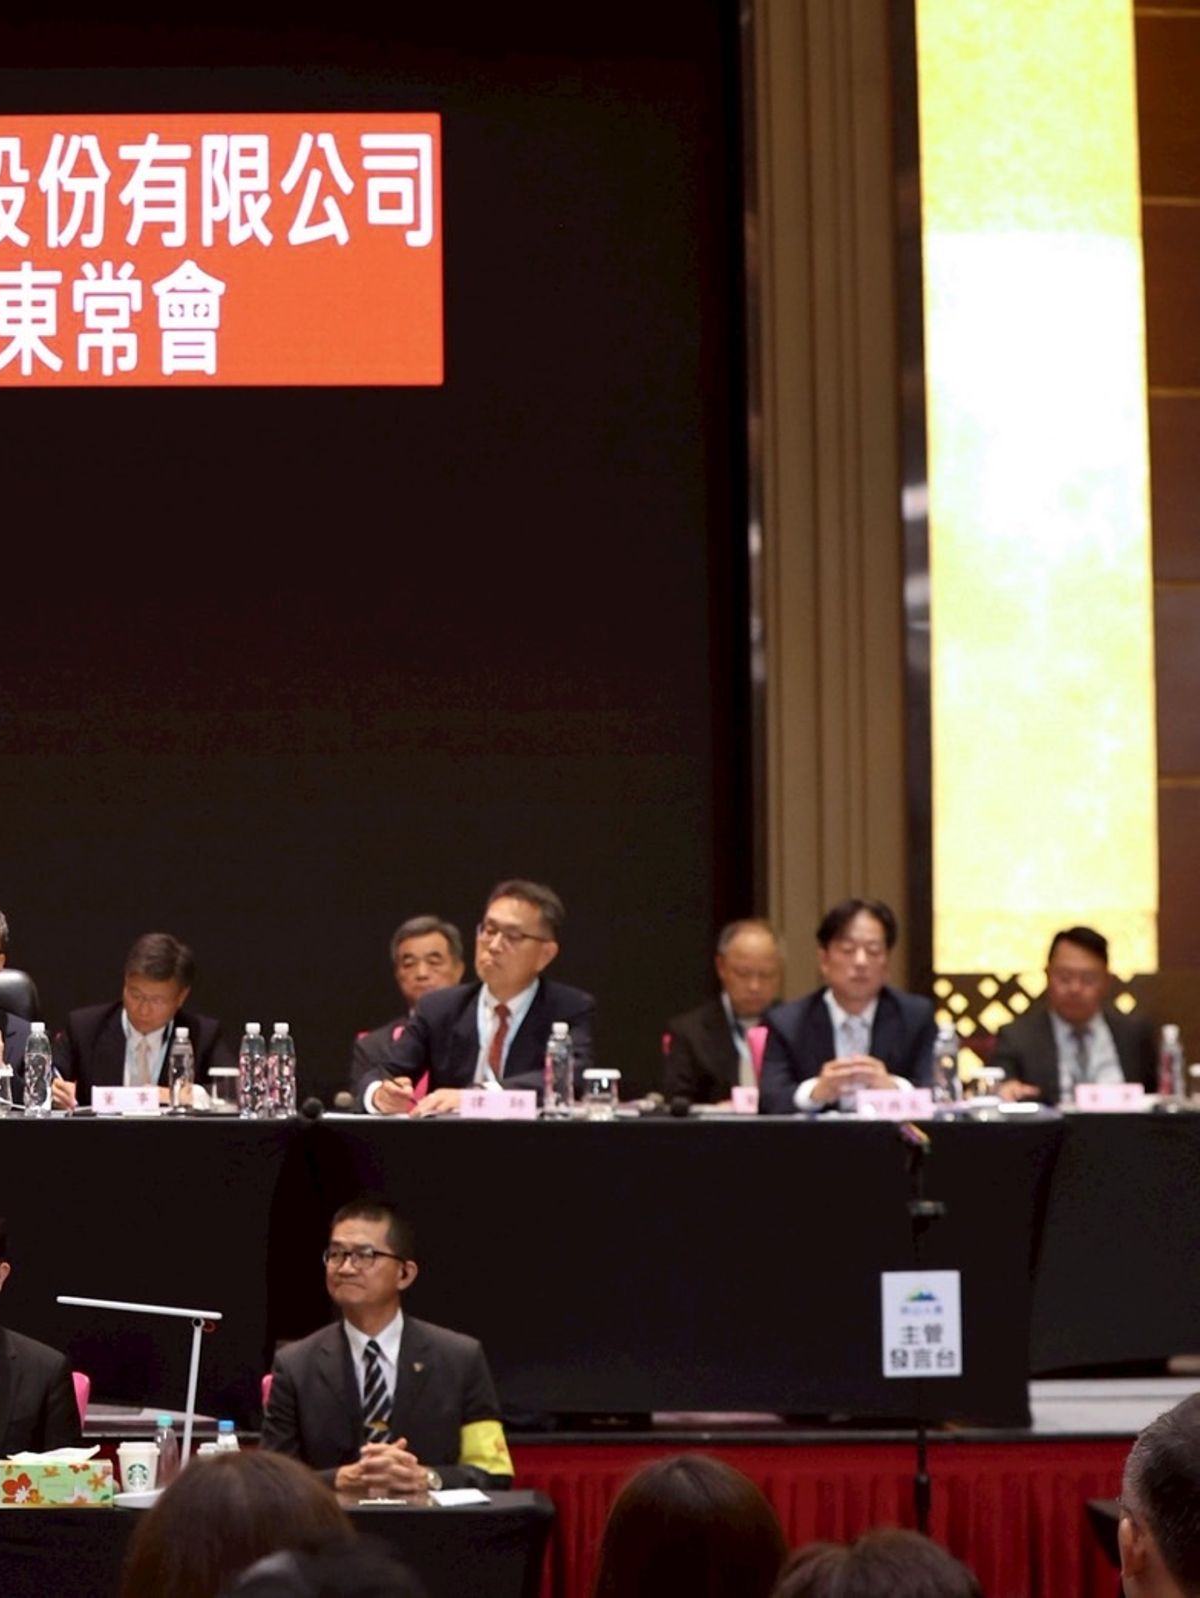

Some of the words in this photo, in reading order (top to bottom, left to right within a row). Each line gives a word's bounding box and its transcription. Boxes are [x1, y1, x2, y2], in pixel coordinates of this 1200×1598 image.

[899, 1323, 942, 1345] 主管
[890, 1348, 955, 1370] 發言台
